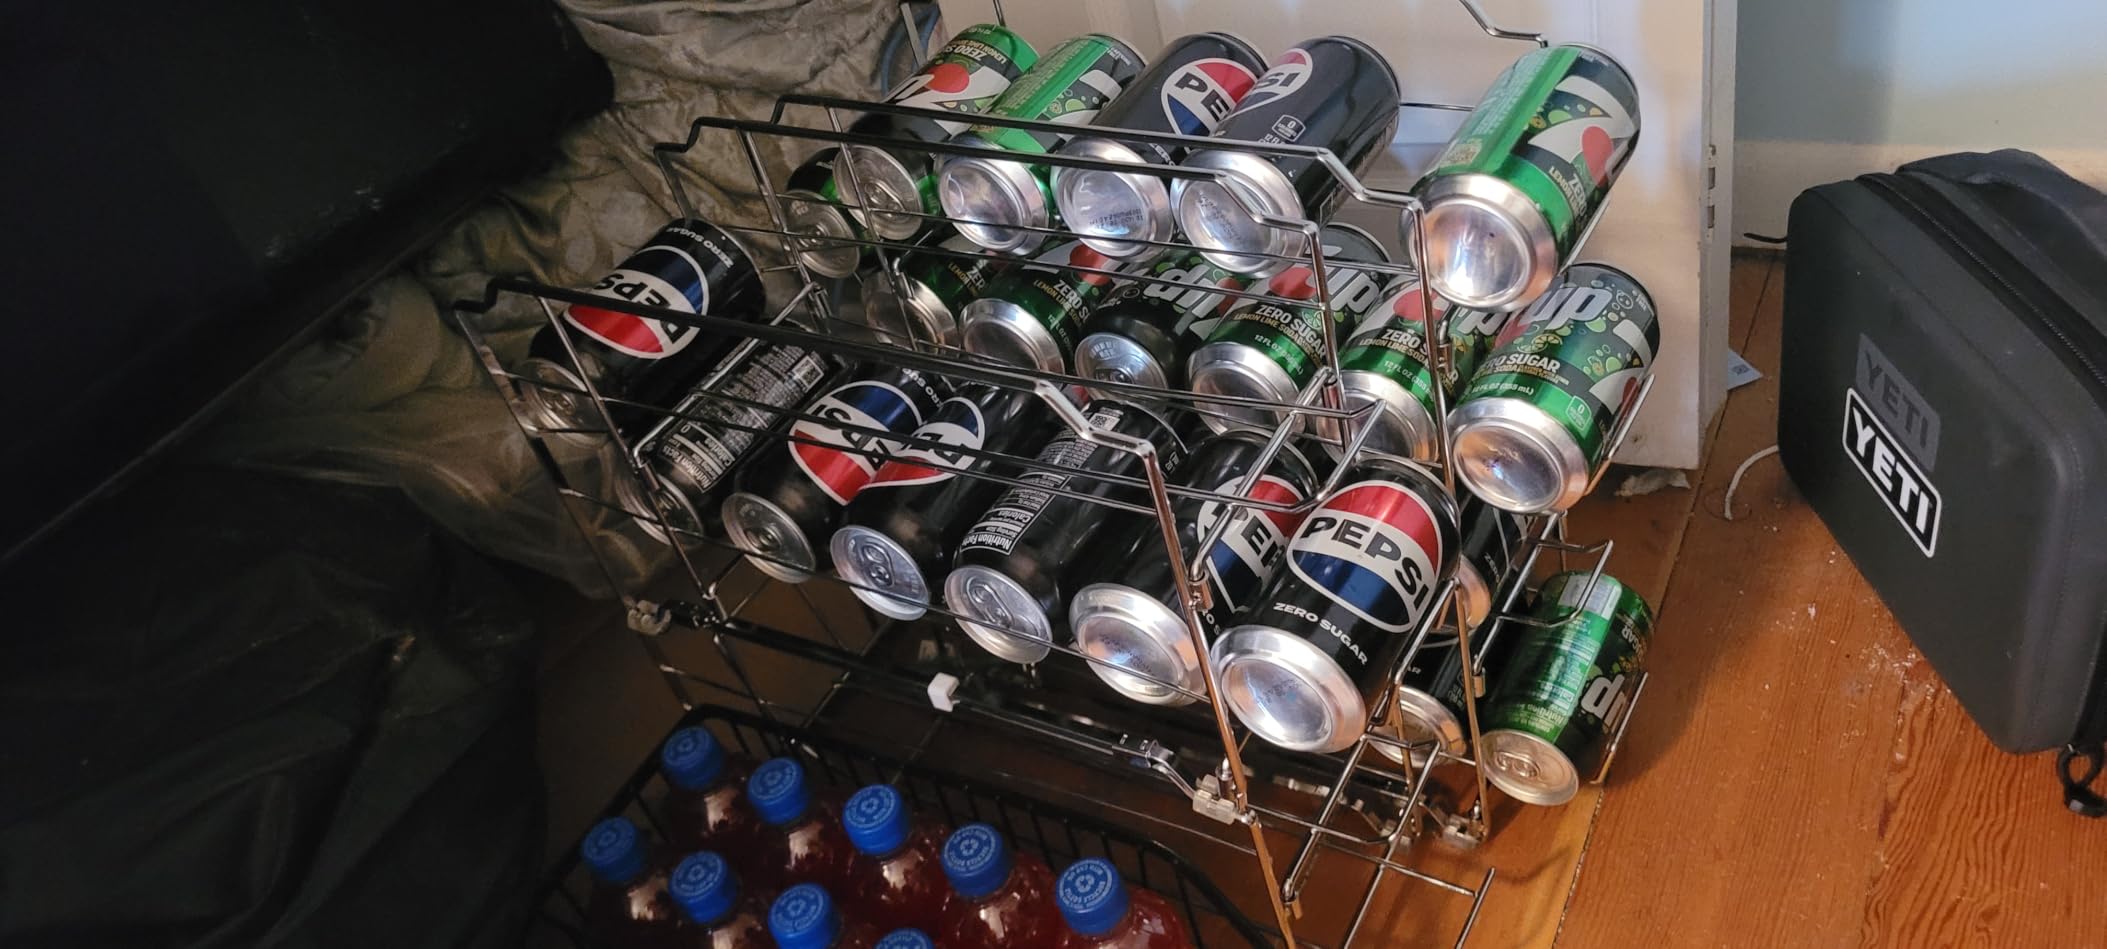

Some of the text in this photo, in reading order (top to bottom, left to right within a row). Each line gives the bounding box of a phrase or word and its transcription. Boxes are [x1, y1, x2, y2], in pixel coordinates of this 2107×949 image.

[954, 45, 988, 61] ZERO
[703, 240, 735, 269] ZERO
[1053, 279, 1083, 309] ZERO
[1233, 313, 1260, 321] LEMON
[1255, 304, 1292, 324] ZERO
[1290, 318, 1328, 358] SUGAR
[1381, 328, 1421, 349] ZERO
[1401, 368, 1414, 379] OZ
[1507, 353, 1561, 373] SUGAR
[1865, 352, 1929, 449] YETI
[680, 424, 691, 434] 0
[704, 437, 733, 467] Calories
[680, 457, 712, 489] Nutrition
[1852, 406, 1930, 534] YETI
[998, 510, 1032, 523] Calories
[977, 533, 1013, 551] Nutrition
[1300, 516, 1430, 613] PEPSI
[1273, 602, 1369, 666] ZERO SUGAR
